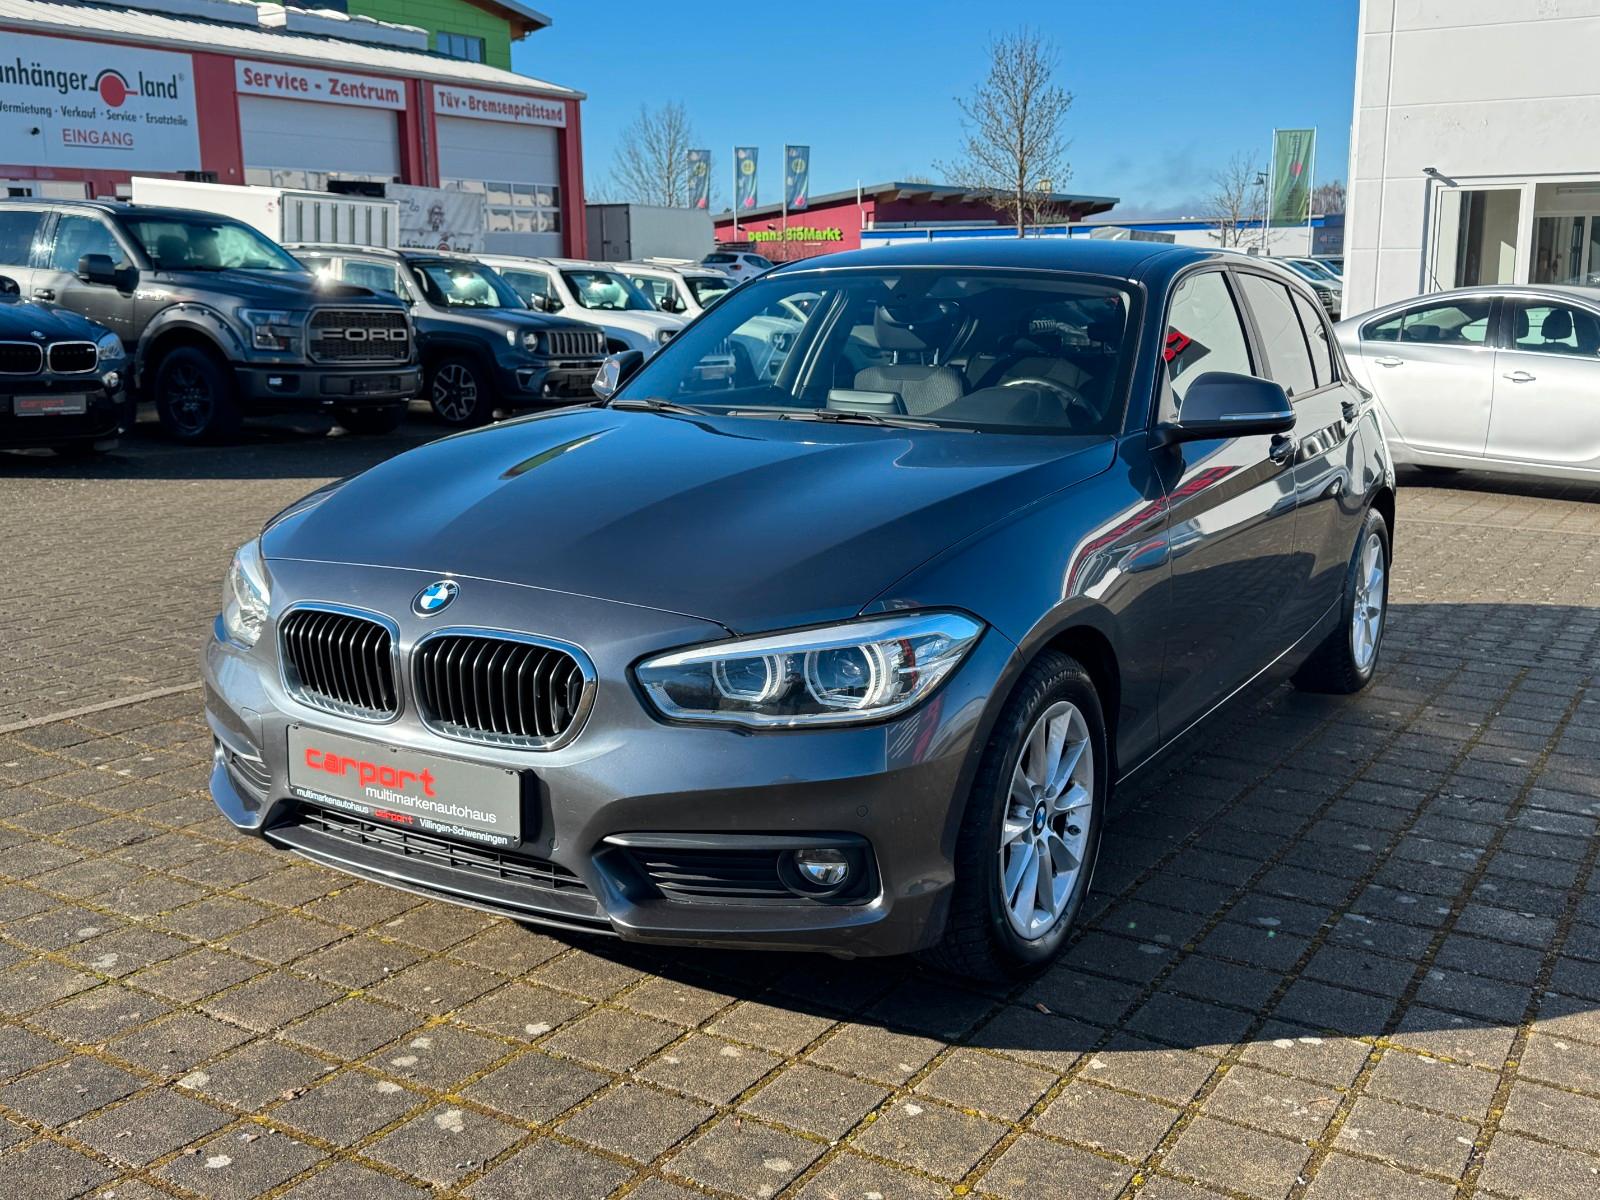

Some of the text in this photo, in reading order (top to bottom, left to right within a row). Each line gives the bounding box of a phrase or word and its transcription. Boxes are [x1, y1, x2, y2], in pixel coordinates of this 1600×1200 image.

[243, 67, 308, 92] Service
[328, 78, 399, 103] Zentrum
[60, 105, 96, 119] Verkauf
[106, 109, 137, 122] Service
[145, 112, 188, 126] Ersatzteile
[62, 128, 134, 147] EINGANG
[319, 327, 408, 341] FORD
[304, 747, 437, 797] carport
[296, 788, 508, 845] multimarkenautohaus carport Villingen-Schwenningen
[365, 786, 497, 824] multimarkenautohaus
